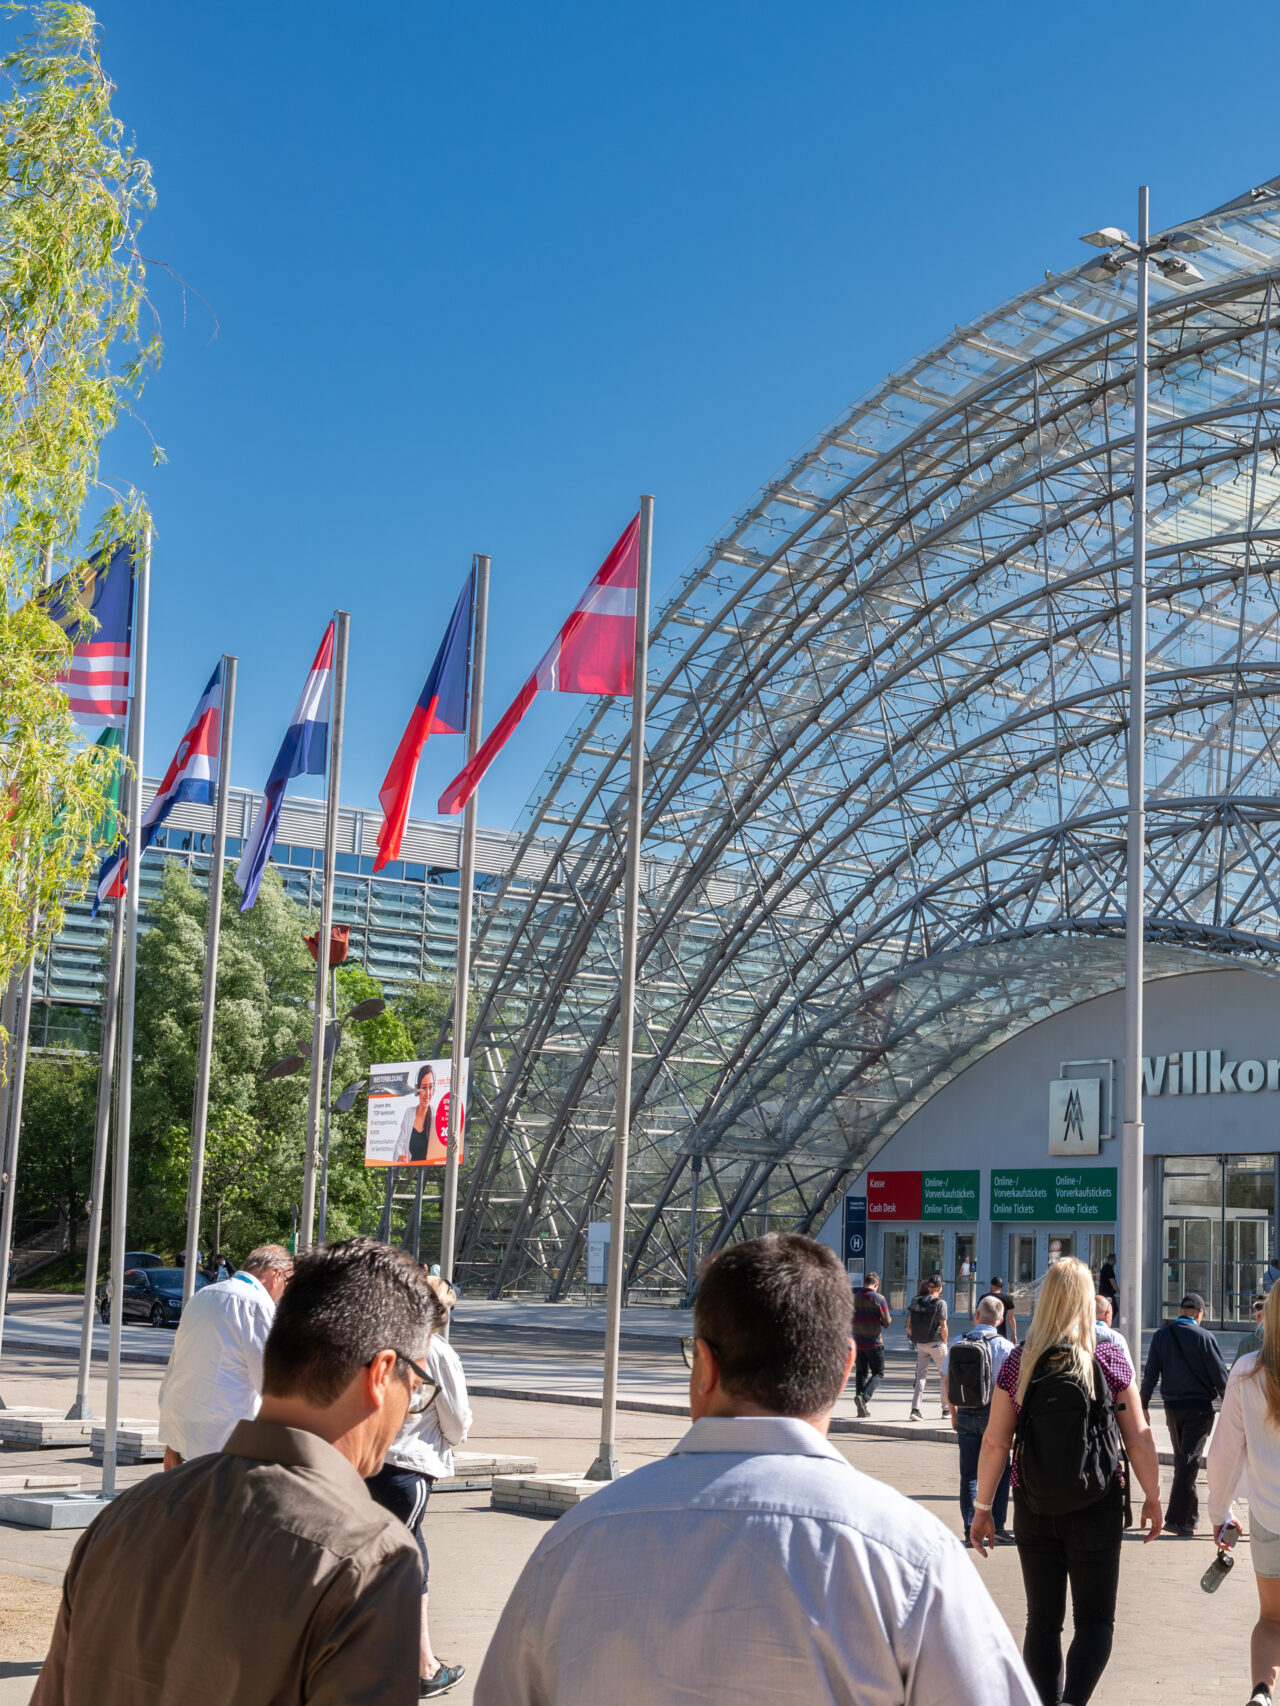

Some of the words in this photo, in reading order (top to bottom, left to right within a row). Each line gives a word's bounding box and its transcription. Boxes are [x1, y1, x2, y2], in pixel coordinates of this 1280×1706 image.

[869, 1179, 885, 1188] Kasse
[925, 1188, 975, 1198] Vorverkaufstickets
[994, 1187, 1047, 1198] Vorverkaufstickets
[1056, 1187, 1112, 1197] Vorverkaufstickets
[869, 1203, 882, 1213] Cash
[883, 1203, 896, 1213] Desk
[925, 1204, 942, 1213] Online
[943, 1204, 962, 1214] Tickets
[993, 1204, 1012, 1214] Online
[1014, 1203, 1034, 1214] Tickets
[1055, 1204, 1075, 1213] Online
[1077, 1203, 1098, 1214] Tickets
